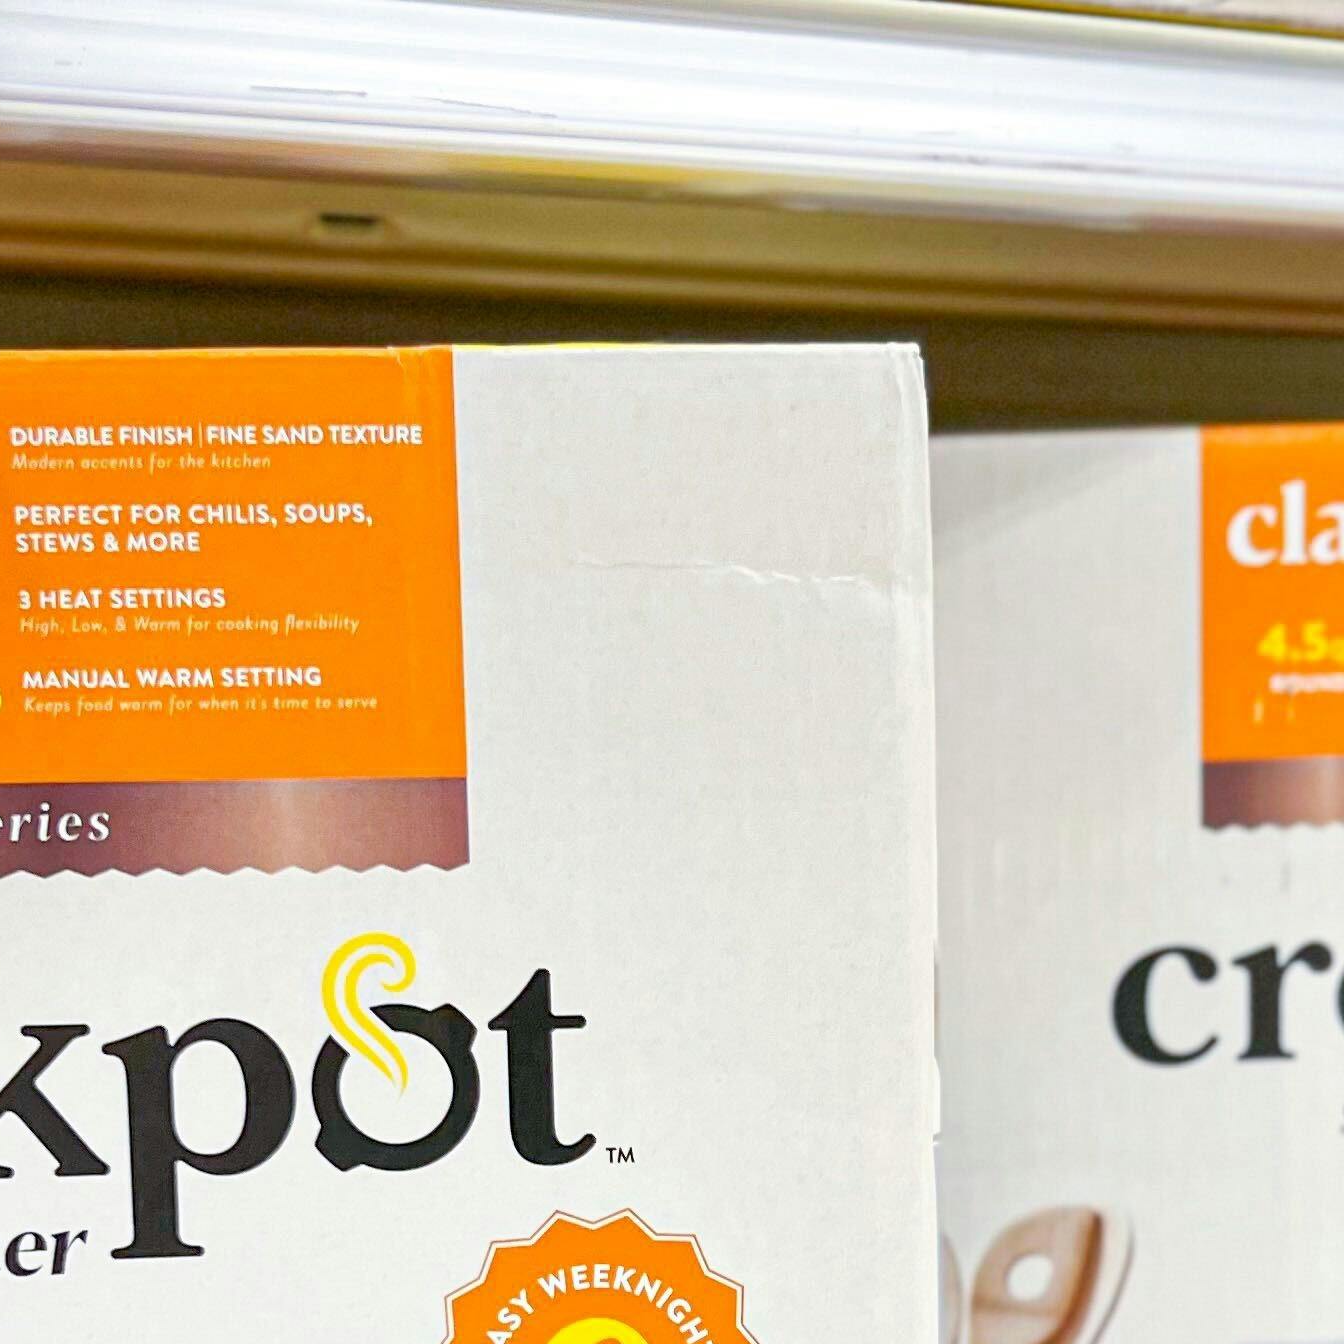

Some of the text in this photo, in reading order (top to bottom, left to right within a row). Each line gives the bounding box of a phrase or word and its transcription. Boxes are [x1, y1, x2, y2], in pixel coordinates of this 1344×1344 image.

[10, 424, 423, 447] DURABLE FINISH FINE SAND TEXTURE
[11, 452, 270, 475] Modern accents for the kitchen
[15, 503, 373, 528] PERFECT FOR CHILIS, SOUPS,
[16, 532, 201, 553] STEWS & MORE
[18, 587, 226, 609] 3 HEAT SETTINGS
[20, 613, 360, 638] High, Low, & Warm for cooking flexibility
[23, 667, 322, 690] MANUAL WARM SETTING
[24, 697, 72, 715] Keeps
[77, 696, 113, 717] food
[119, 699, 163, 713] warm
[168, 695, 193, 717] for
[198, 695, 240, 712] when
[274, 694, 310, 711] time
[316, 696, 332, 710] to
[337, 696, 378, 710] serve
